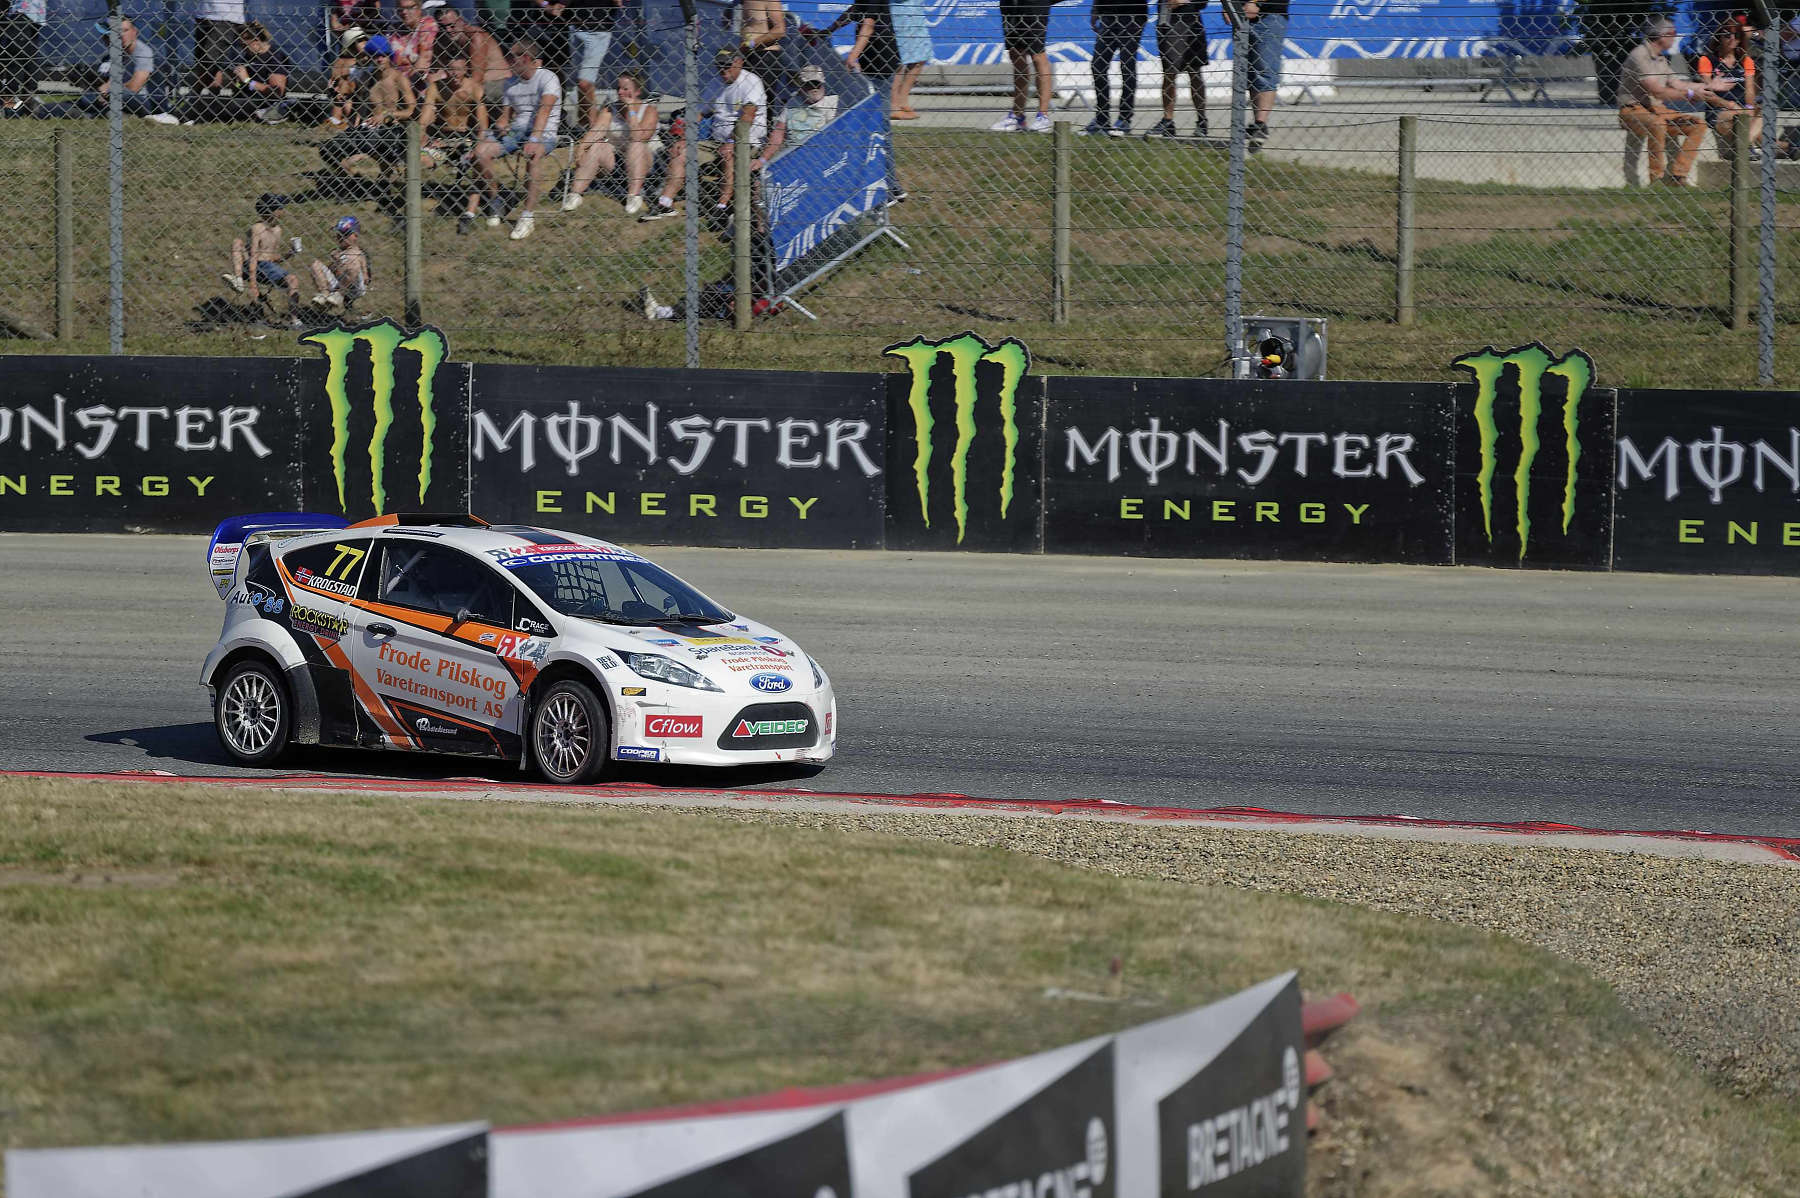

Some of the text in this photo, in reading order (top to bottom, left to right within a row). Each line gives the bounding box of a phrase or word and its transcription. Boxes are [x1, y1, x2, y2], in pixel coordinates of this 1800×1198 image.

[0, 393, 272, 459] NSTER
[470, 401, 882, 477] MONSTER
[1064, 417, 1426, 486] MONSTER
[536, 490, 819, 520] ENERGY
[1120, 498, 1371, 525] ENERGY
[325, 543, 366, 581] 77
[307, 575, 357, 597] KROGSTAD
[230, 590, 285, 614] Auto 88
[290, 604, 349, 634] ROCKSTAR
[294, 620, 319, 634] ENERGY
[688, 644, 761, 655] SpareBank
[721, 656, 788, 665] Frode Pilskog
[379, 642, 507, 700] Frode Pilskog
[728, 664, 794, 673] Varetransport
[376, 668, 504, 718] Varetransport AS
[758, 675, 786, 690] Ford
[649, 718, 698, 735] Cflow
[749, 720, 807, 735] VEIDEC
[620, 748, 657, 758] COOPER
[1187, 1087, 1290, 1191] BRETAGNE
